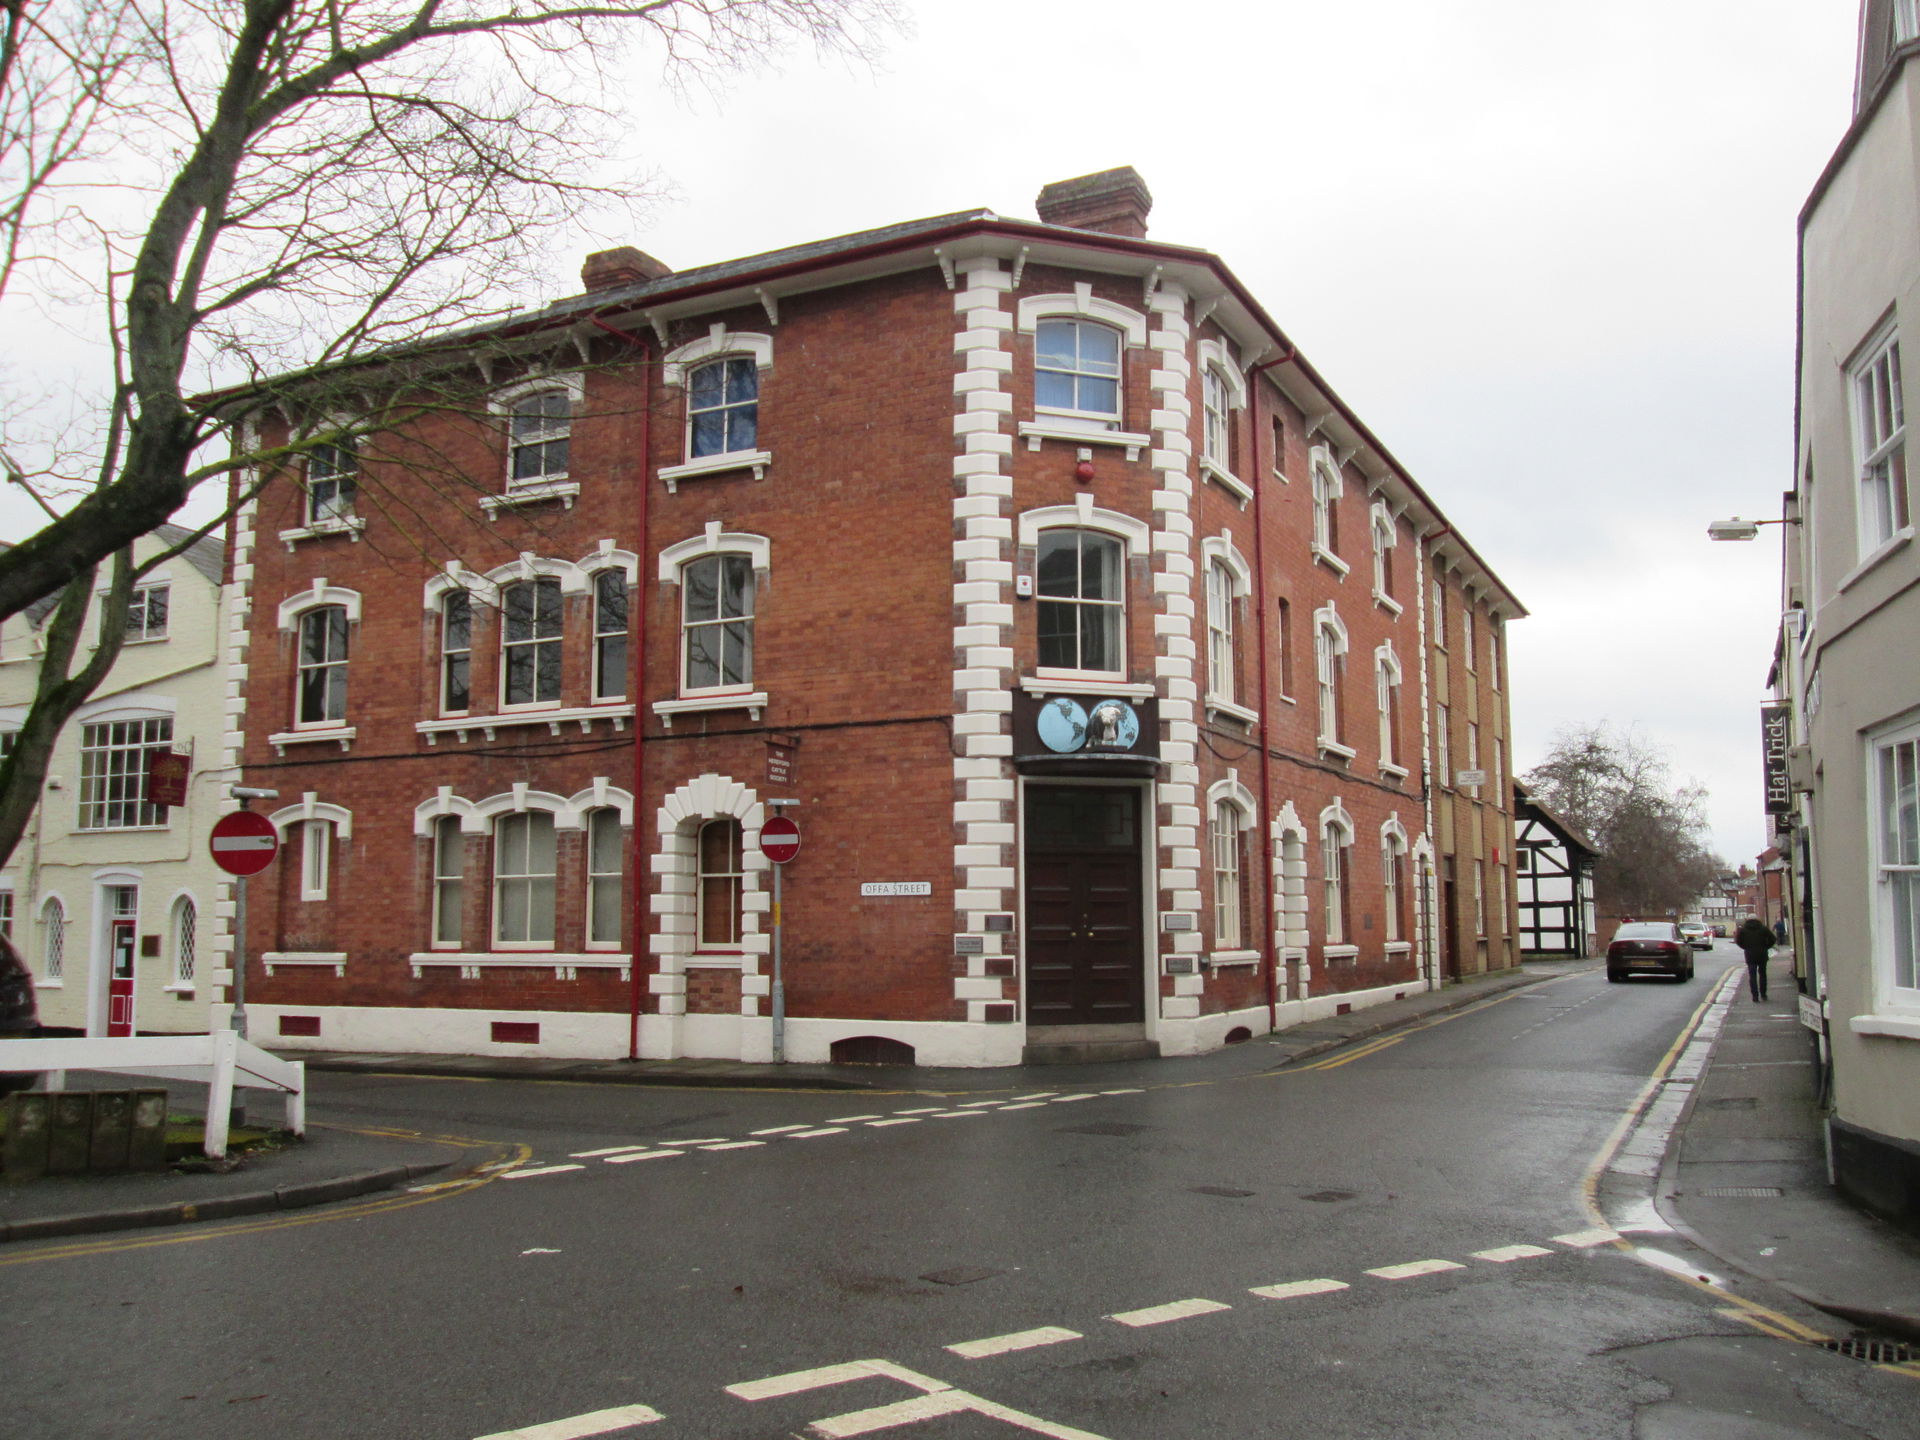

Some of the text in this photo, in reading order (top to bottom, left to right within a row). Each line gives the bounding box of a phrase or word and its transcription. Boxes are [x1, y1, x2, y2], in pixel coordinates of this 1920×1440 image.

[1765, 716, 1785, 764] Trick
[1767, 769, 1786, 803] Hat
[865, 884, 927, 894] OFFA STREET
